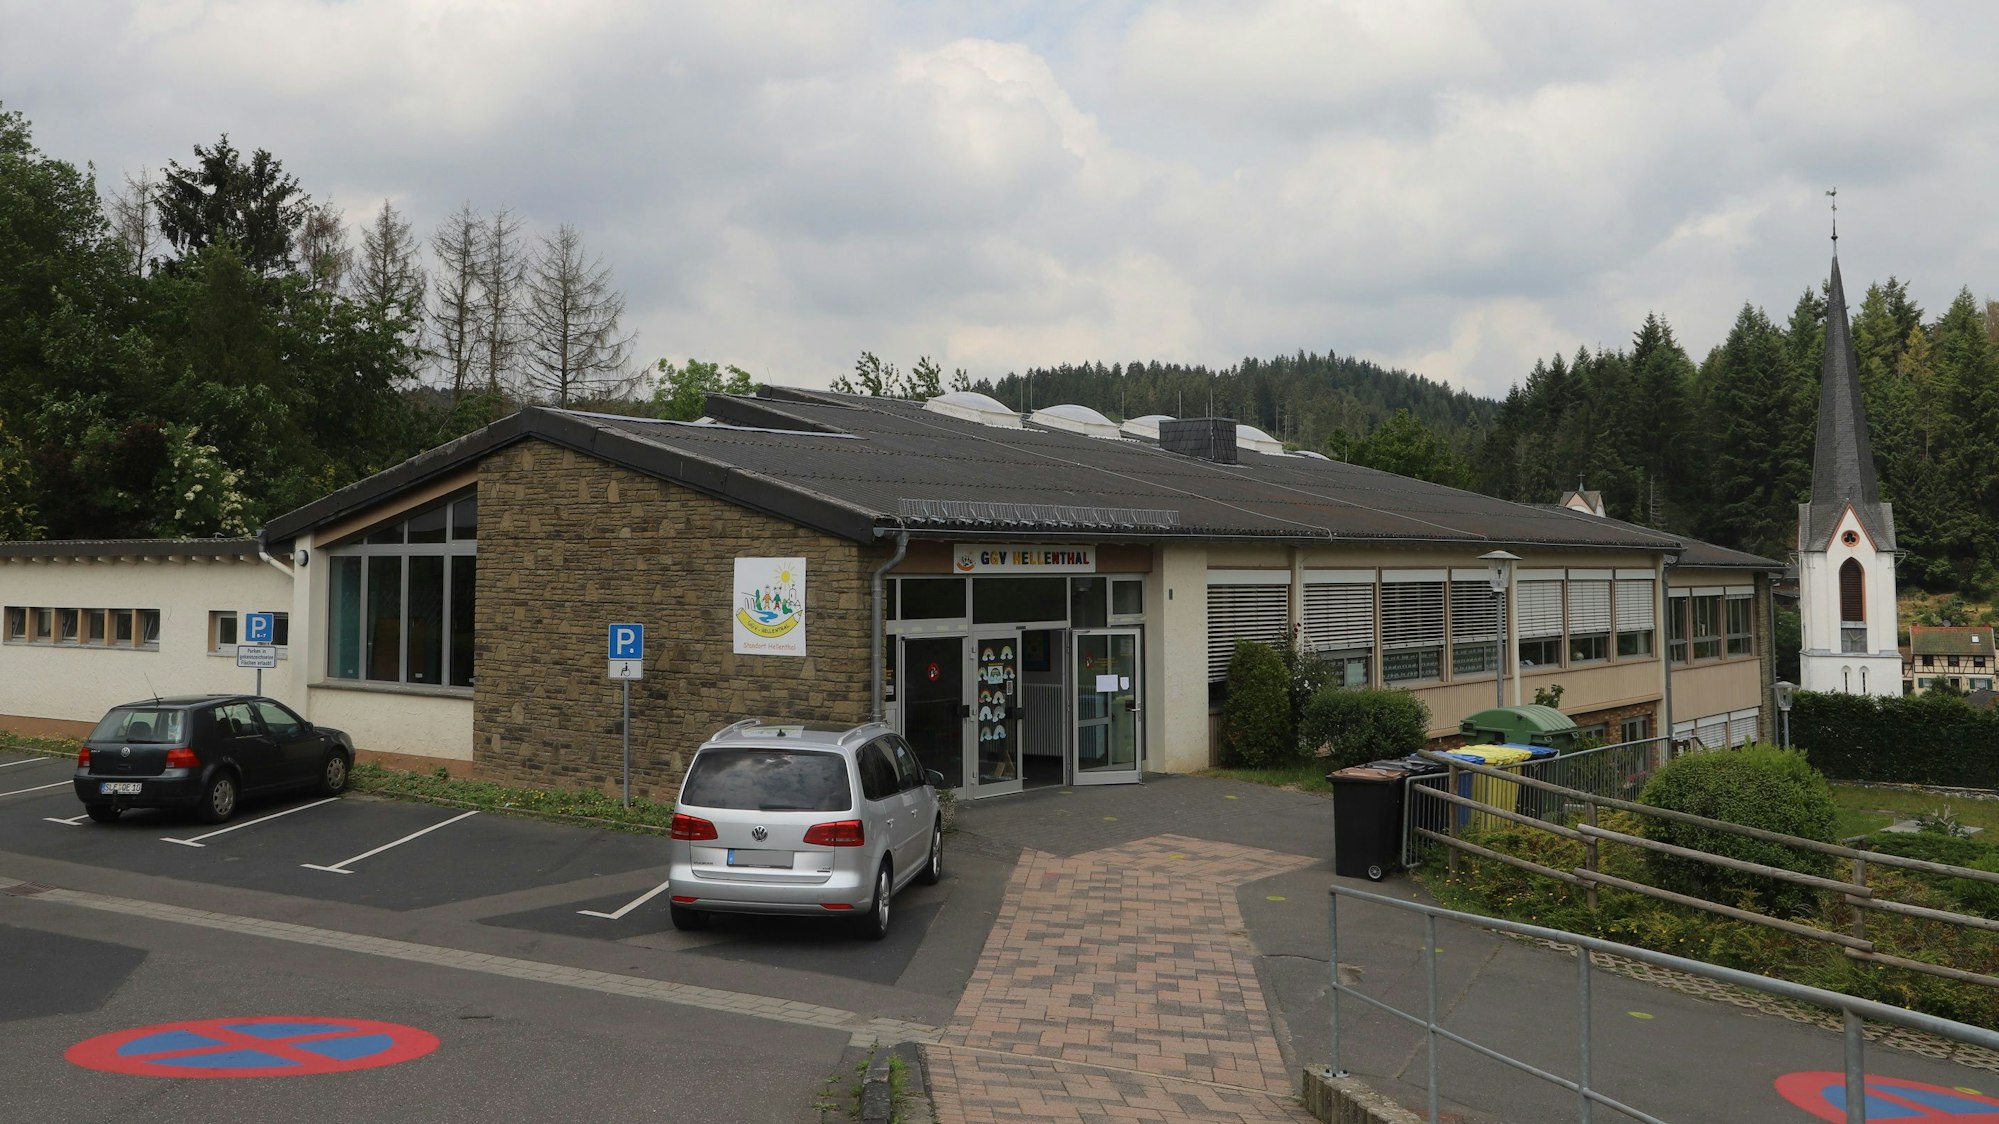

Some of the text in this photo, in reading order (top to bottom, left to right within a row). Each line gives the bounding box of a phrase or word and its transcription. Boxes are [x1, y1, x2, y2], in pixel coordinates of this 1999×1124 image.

[980, 551, 1090, 565] GGV HELLENTHAL
[252, 616, 267, 639] P
[616, 628, 635, 655] P
[743, 642, 796, 651] Standort Hellenthal
